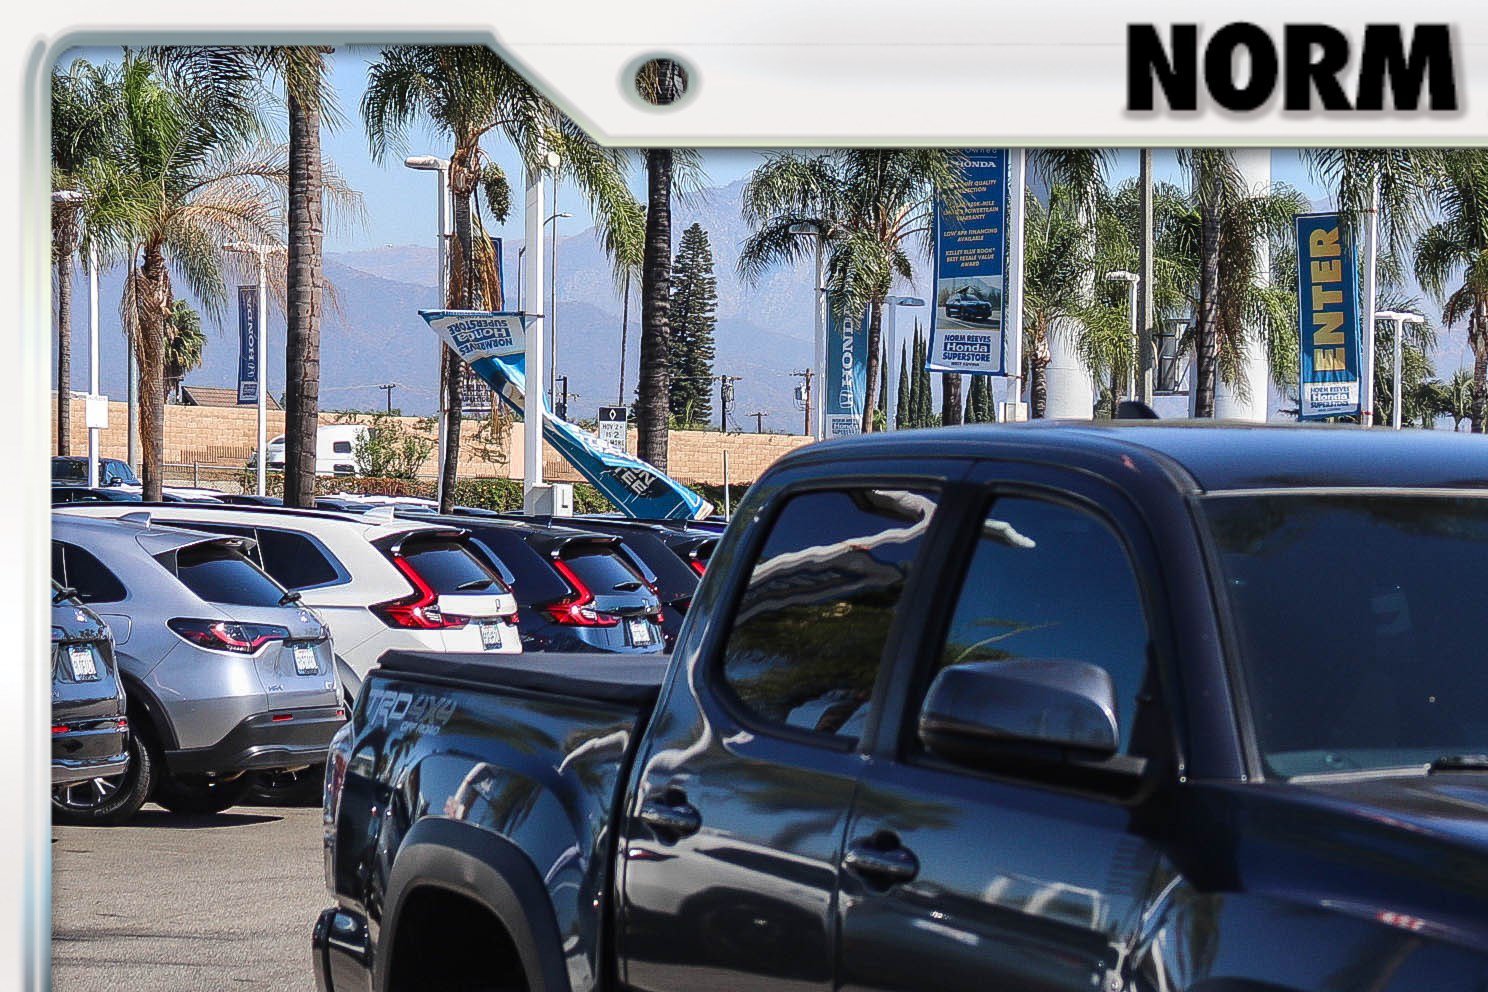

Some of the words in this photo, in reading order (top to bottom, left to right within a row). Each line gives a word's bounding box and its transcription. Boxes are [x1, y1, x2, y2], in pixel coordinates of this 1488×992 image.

[1309, 227, 1346, 371] ENTER
[246, 296, 255, 361] HONDA
[447, 319, 508, 336] SUPERSTORE
[459, 328, 508, 342] Honda
[944, 334, 966, 342] NORM
[967, 335, 991, 343] REEVES
[946, 342, 988, 353] Honda
[942, 352, 991, 362] SUPERSTORE
[1312, 392, 1348, 401] Honda
[613, 431, 620, 439] 2
[366, 688, 414, 729] TRD
